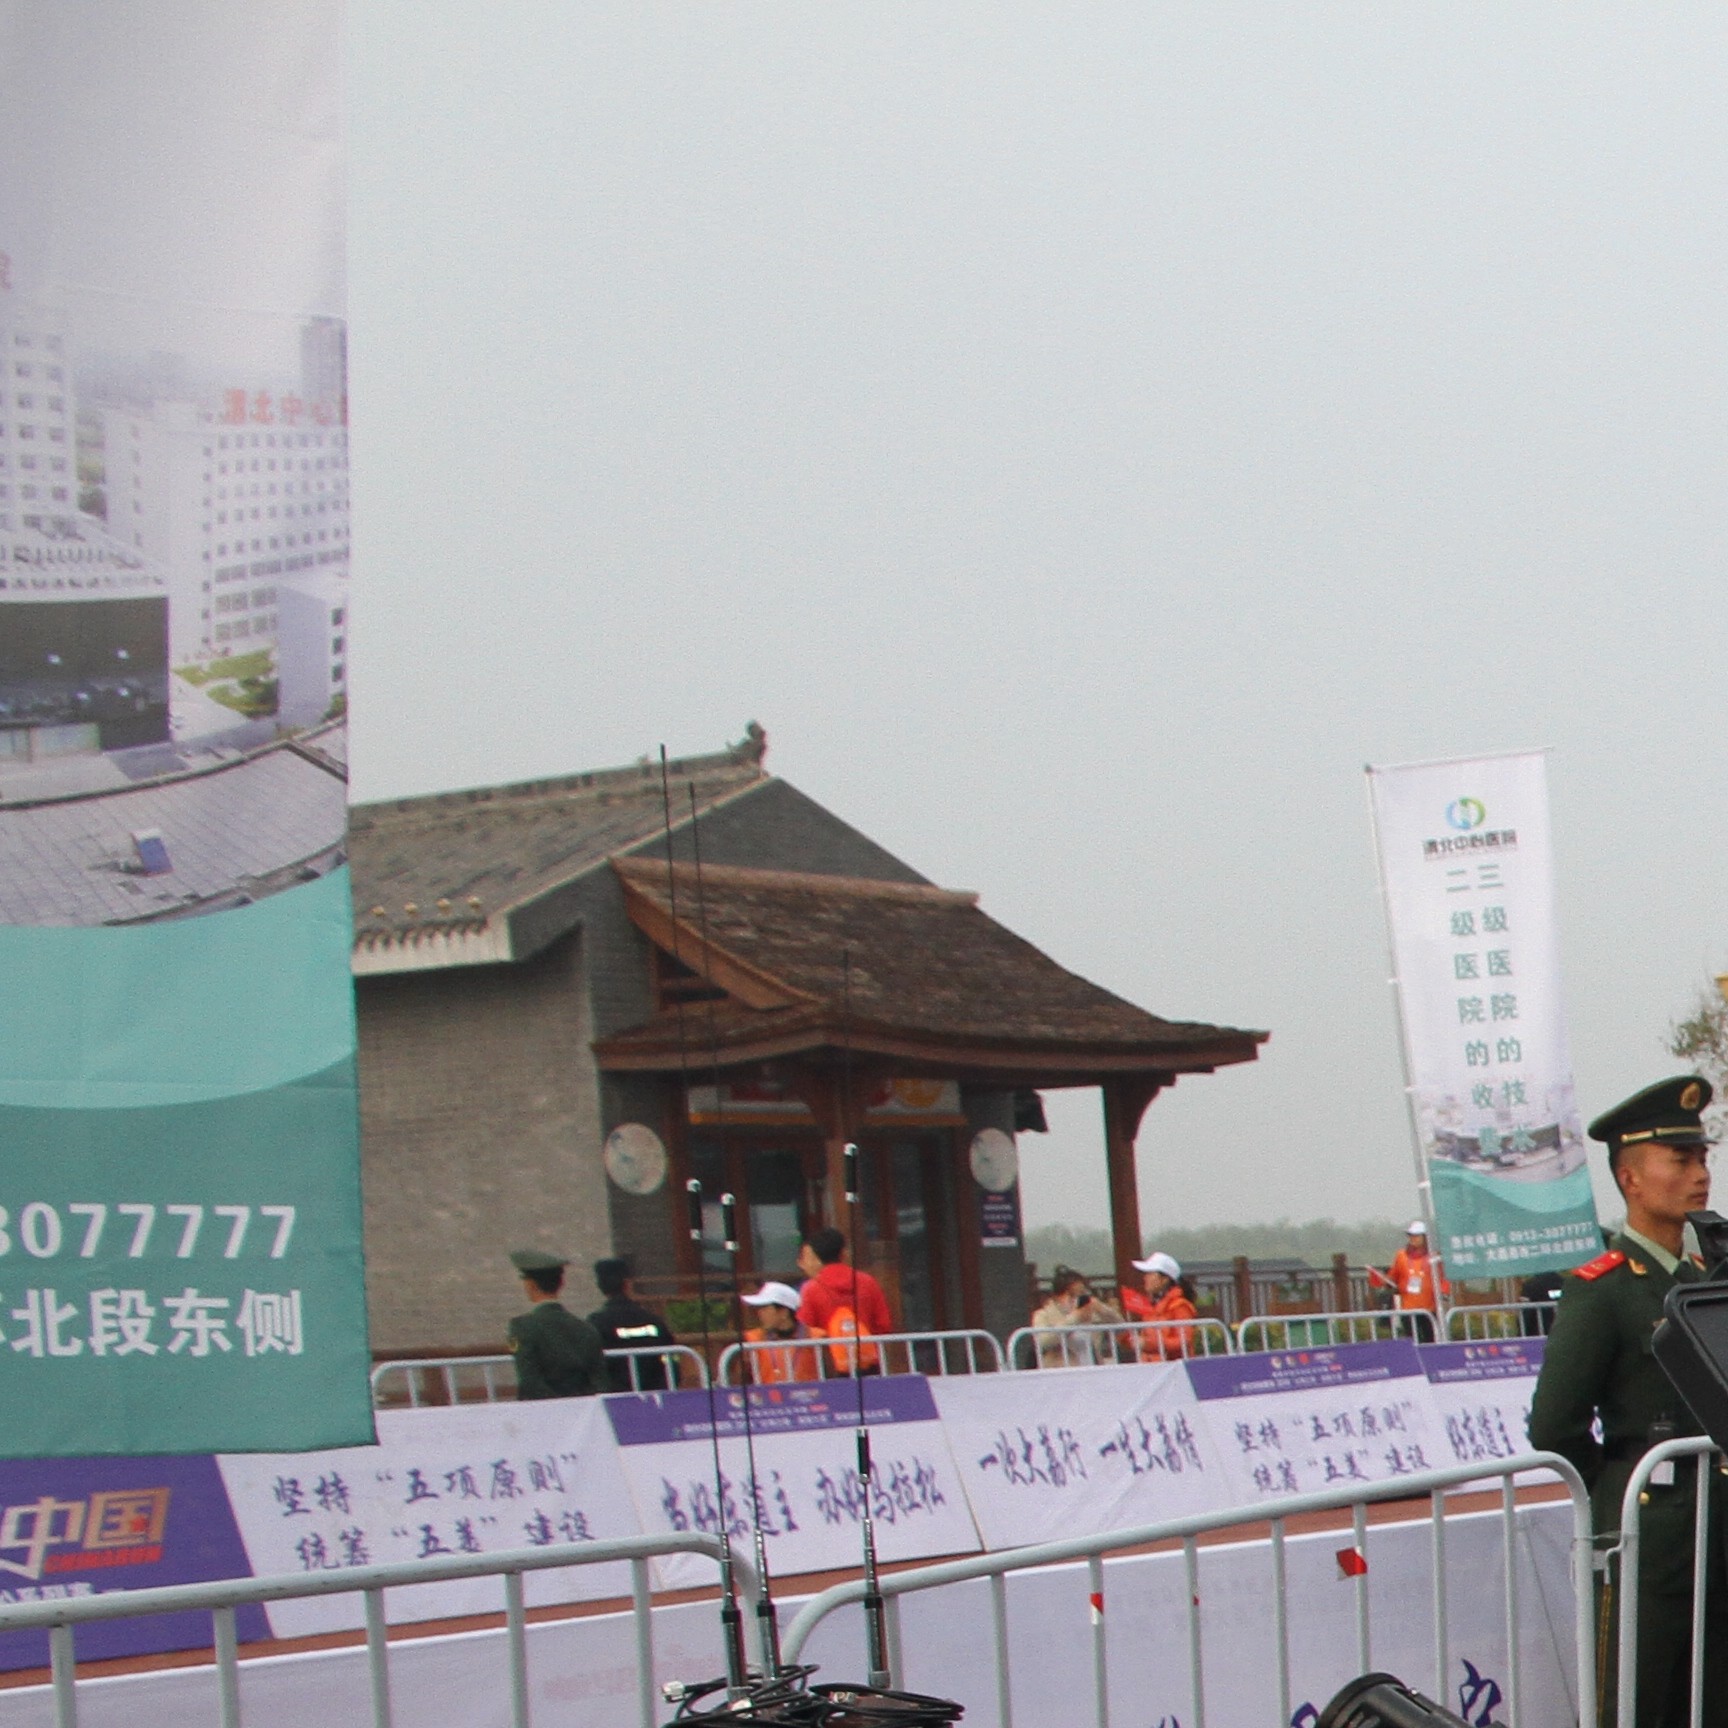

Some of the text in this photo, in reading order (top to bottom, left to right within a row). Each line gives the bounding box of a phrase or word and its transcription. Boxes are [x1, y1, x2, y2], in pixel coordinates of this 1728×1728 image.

[0, 1202, 296, 1259] 077777
[0, 1287, 303, 1358] 北段东侧
